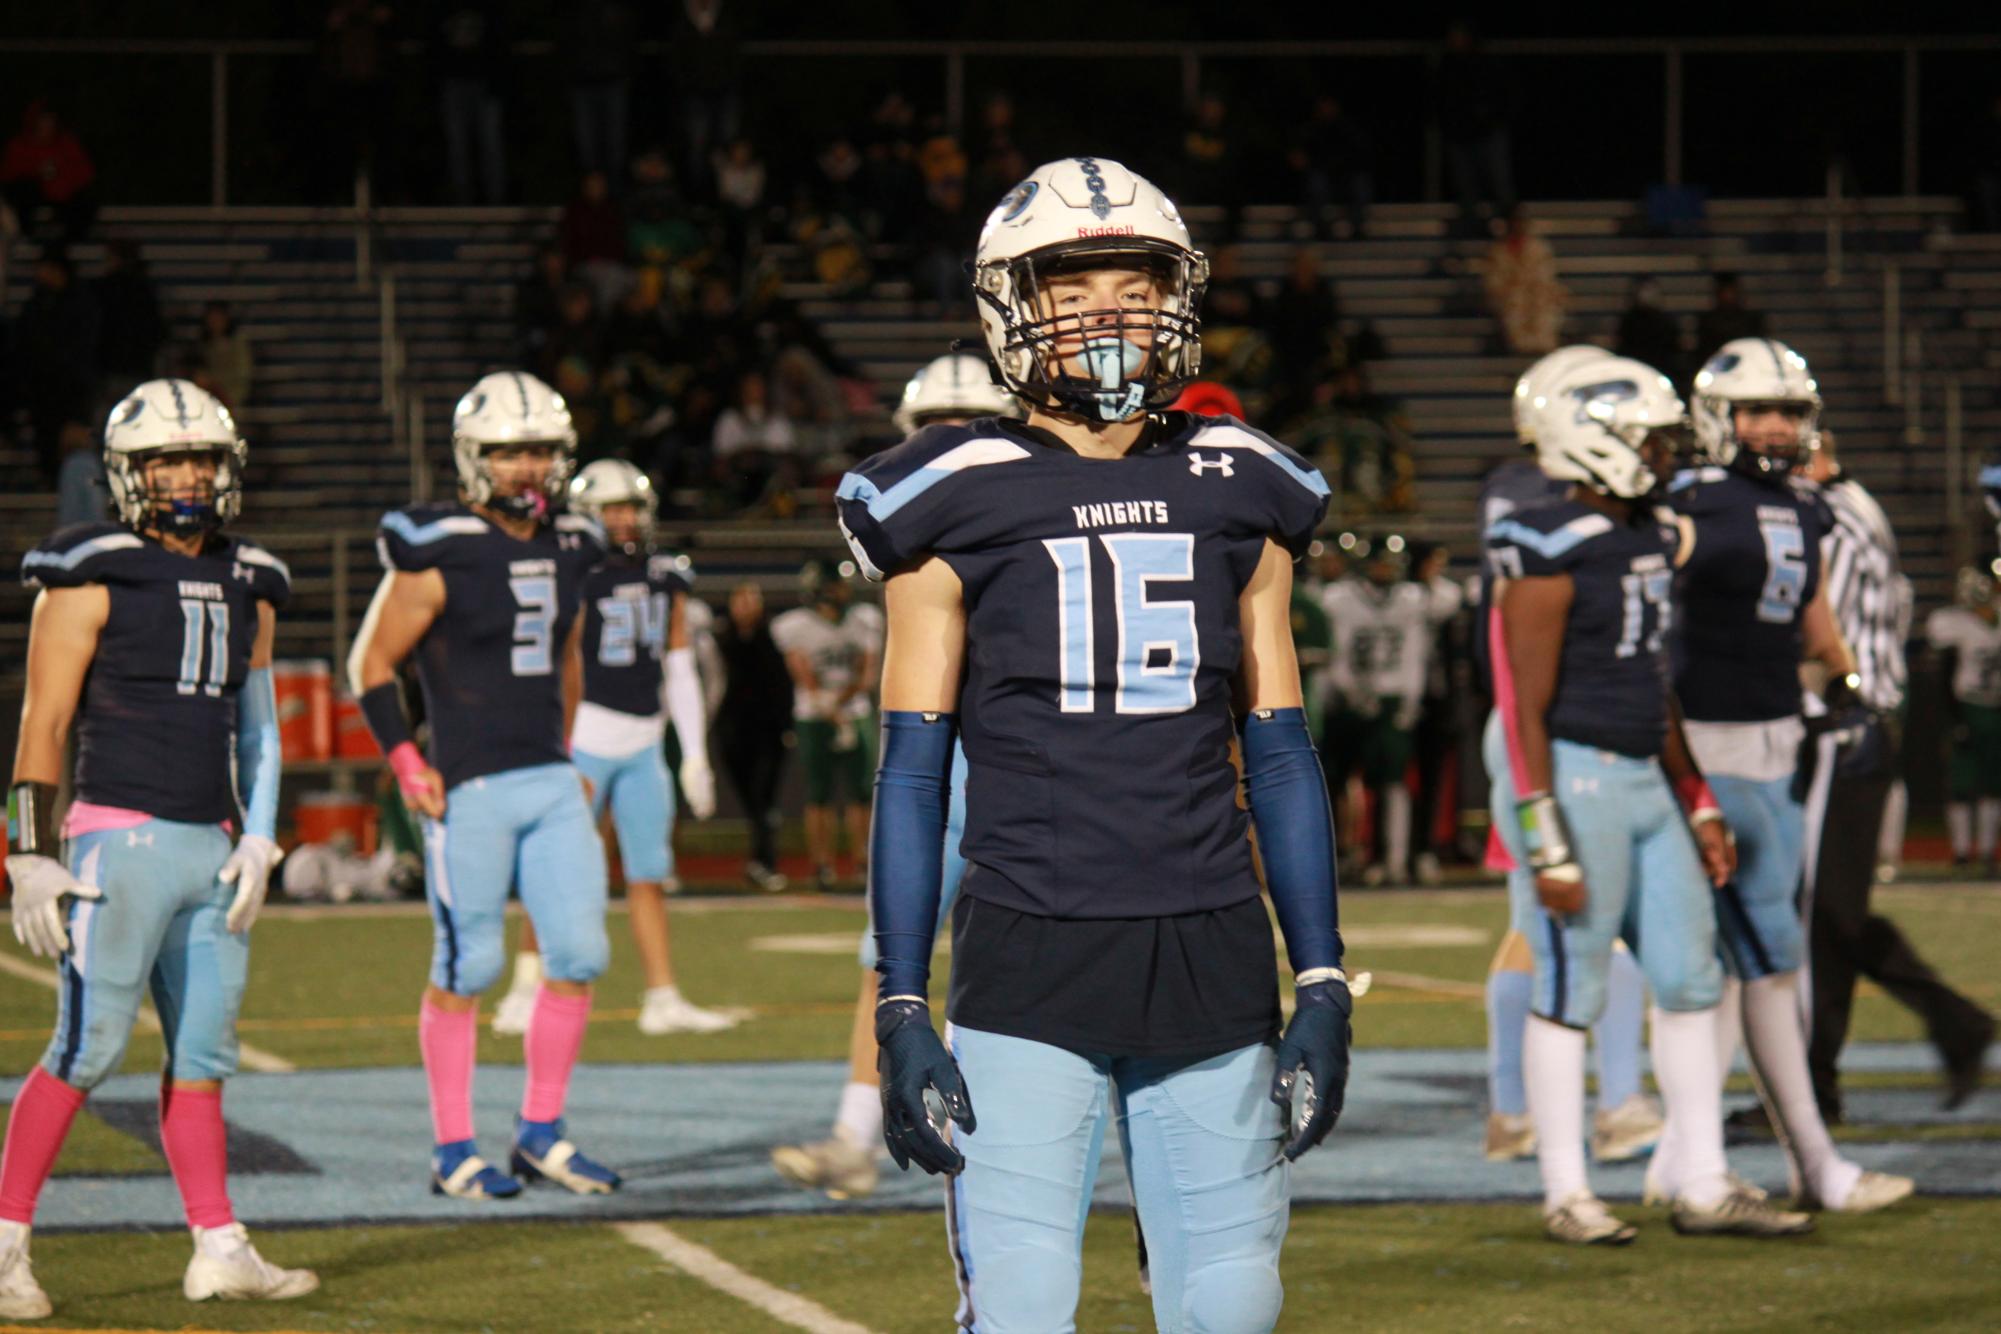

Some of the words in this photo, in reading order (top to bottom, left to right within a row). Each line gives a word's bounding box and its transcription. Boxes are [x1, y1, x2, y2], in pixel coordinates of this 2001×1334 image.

[1077, 224, 1135, 238] Riddell
[1072, 500, 1169, 529] KNIGHTS
[1757, 521, 1808, 623] 6
[176, 599, 230, 697] 11
[508, 575, 559, 676] 3
[597, 591, 669, 667] 24
[1041, 532, 1201, 714] 16
